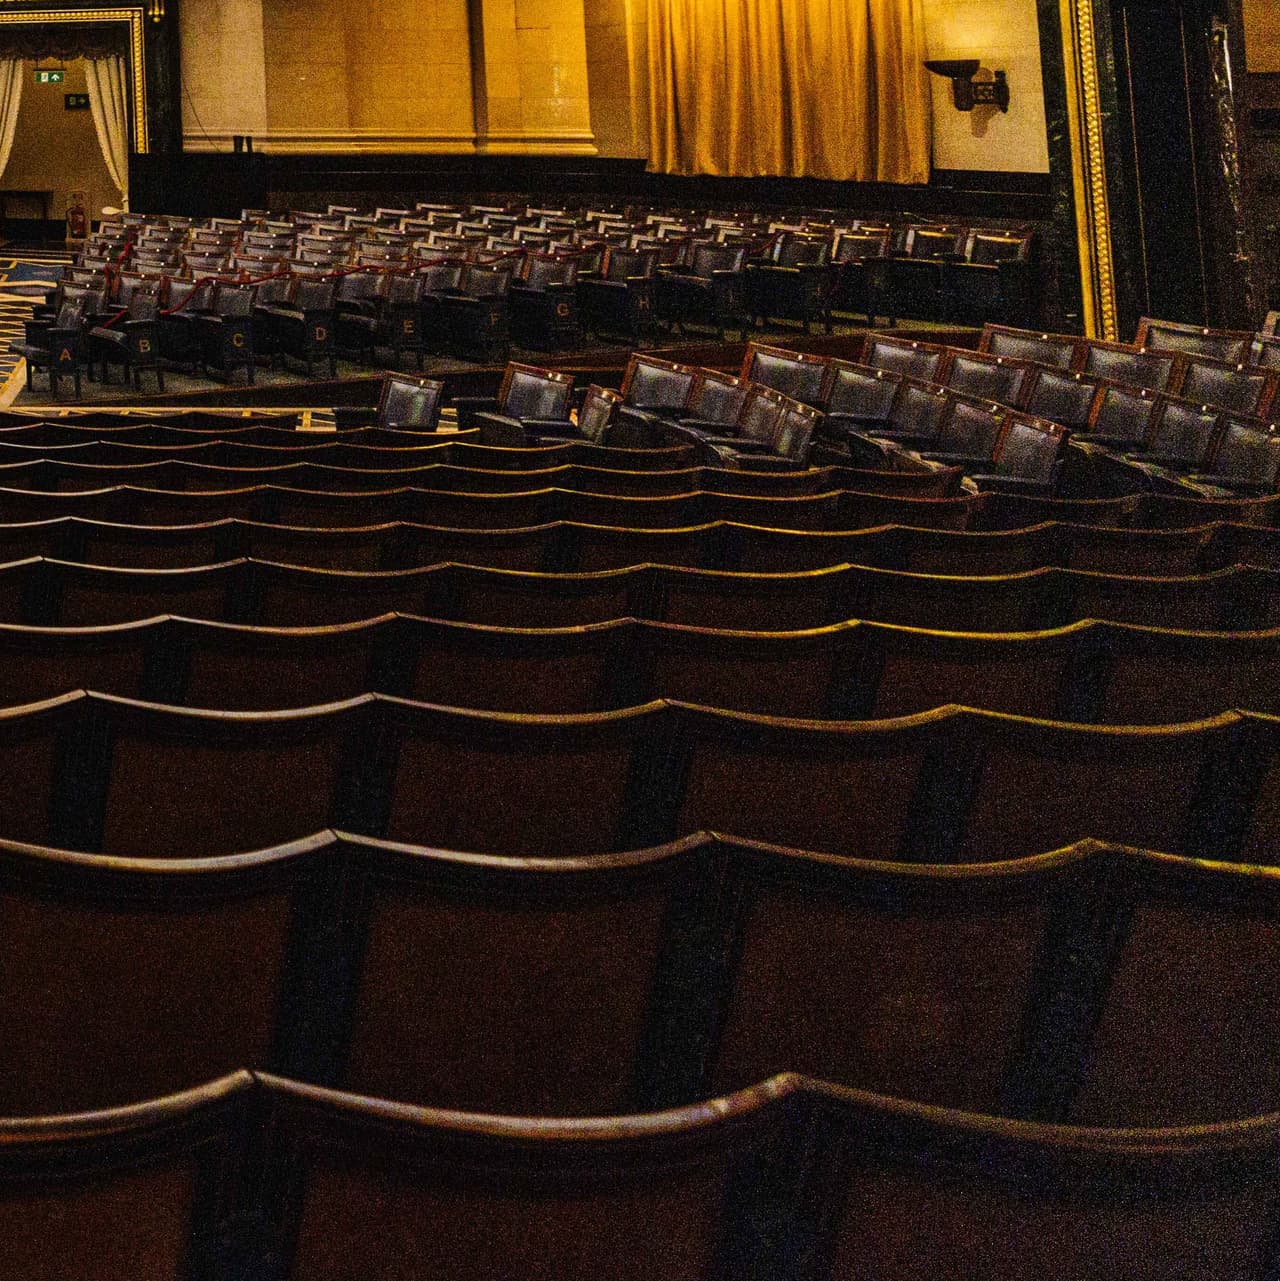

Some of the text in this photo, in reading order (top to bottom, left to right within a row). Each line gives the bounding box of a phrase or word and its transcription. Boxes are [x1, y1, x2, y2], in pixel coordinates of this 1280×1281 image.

[556, 303, 569, 317] G
[639, 296, 650, 310] H
[316, 326, 327, 341] D
[403, 320, 415, 334] E
[139, 339, 151, 353] B
[232, 333, 244, 347] C
[60, 348, 72, 361] A
